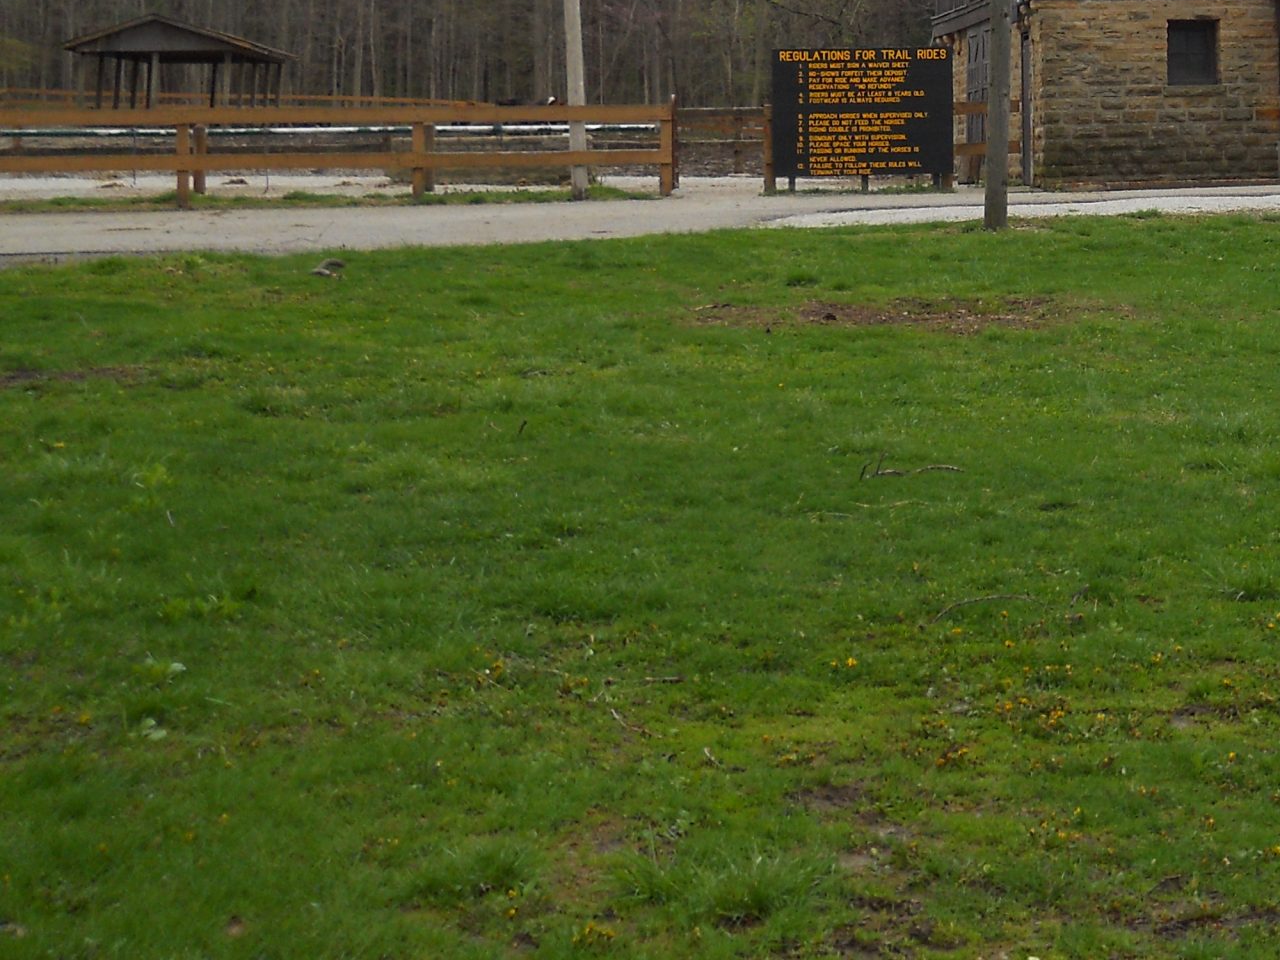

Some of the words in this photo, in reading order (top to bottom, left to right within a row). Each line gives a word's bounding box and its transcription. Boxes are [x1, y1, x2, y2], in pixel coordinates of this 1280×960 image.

[780, 50, 850, 61] REGULATIONS
[855, 50, 875, 61] FOR
[881, 49, 911, 60] TRAIL
[917, 49, 946, 60] RIDES
